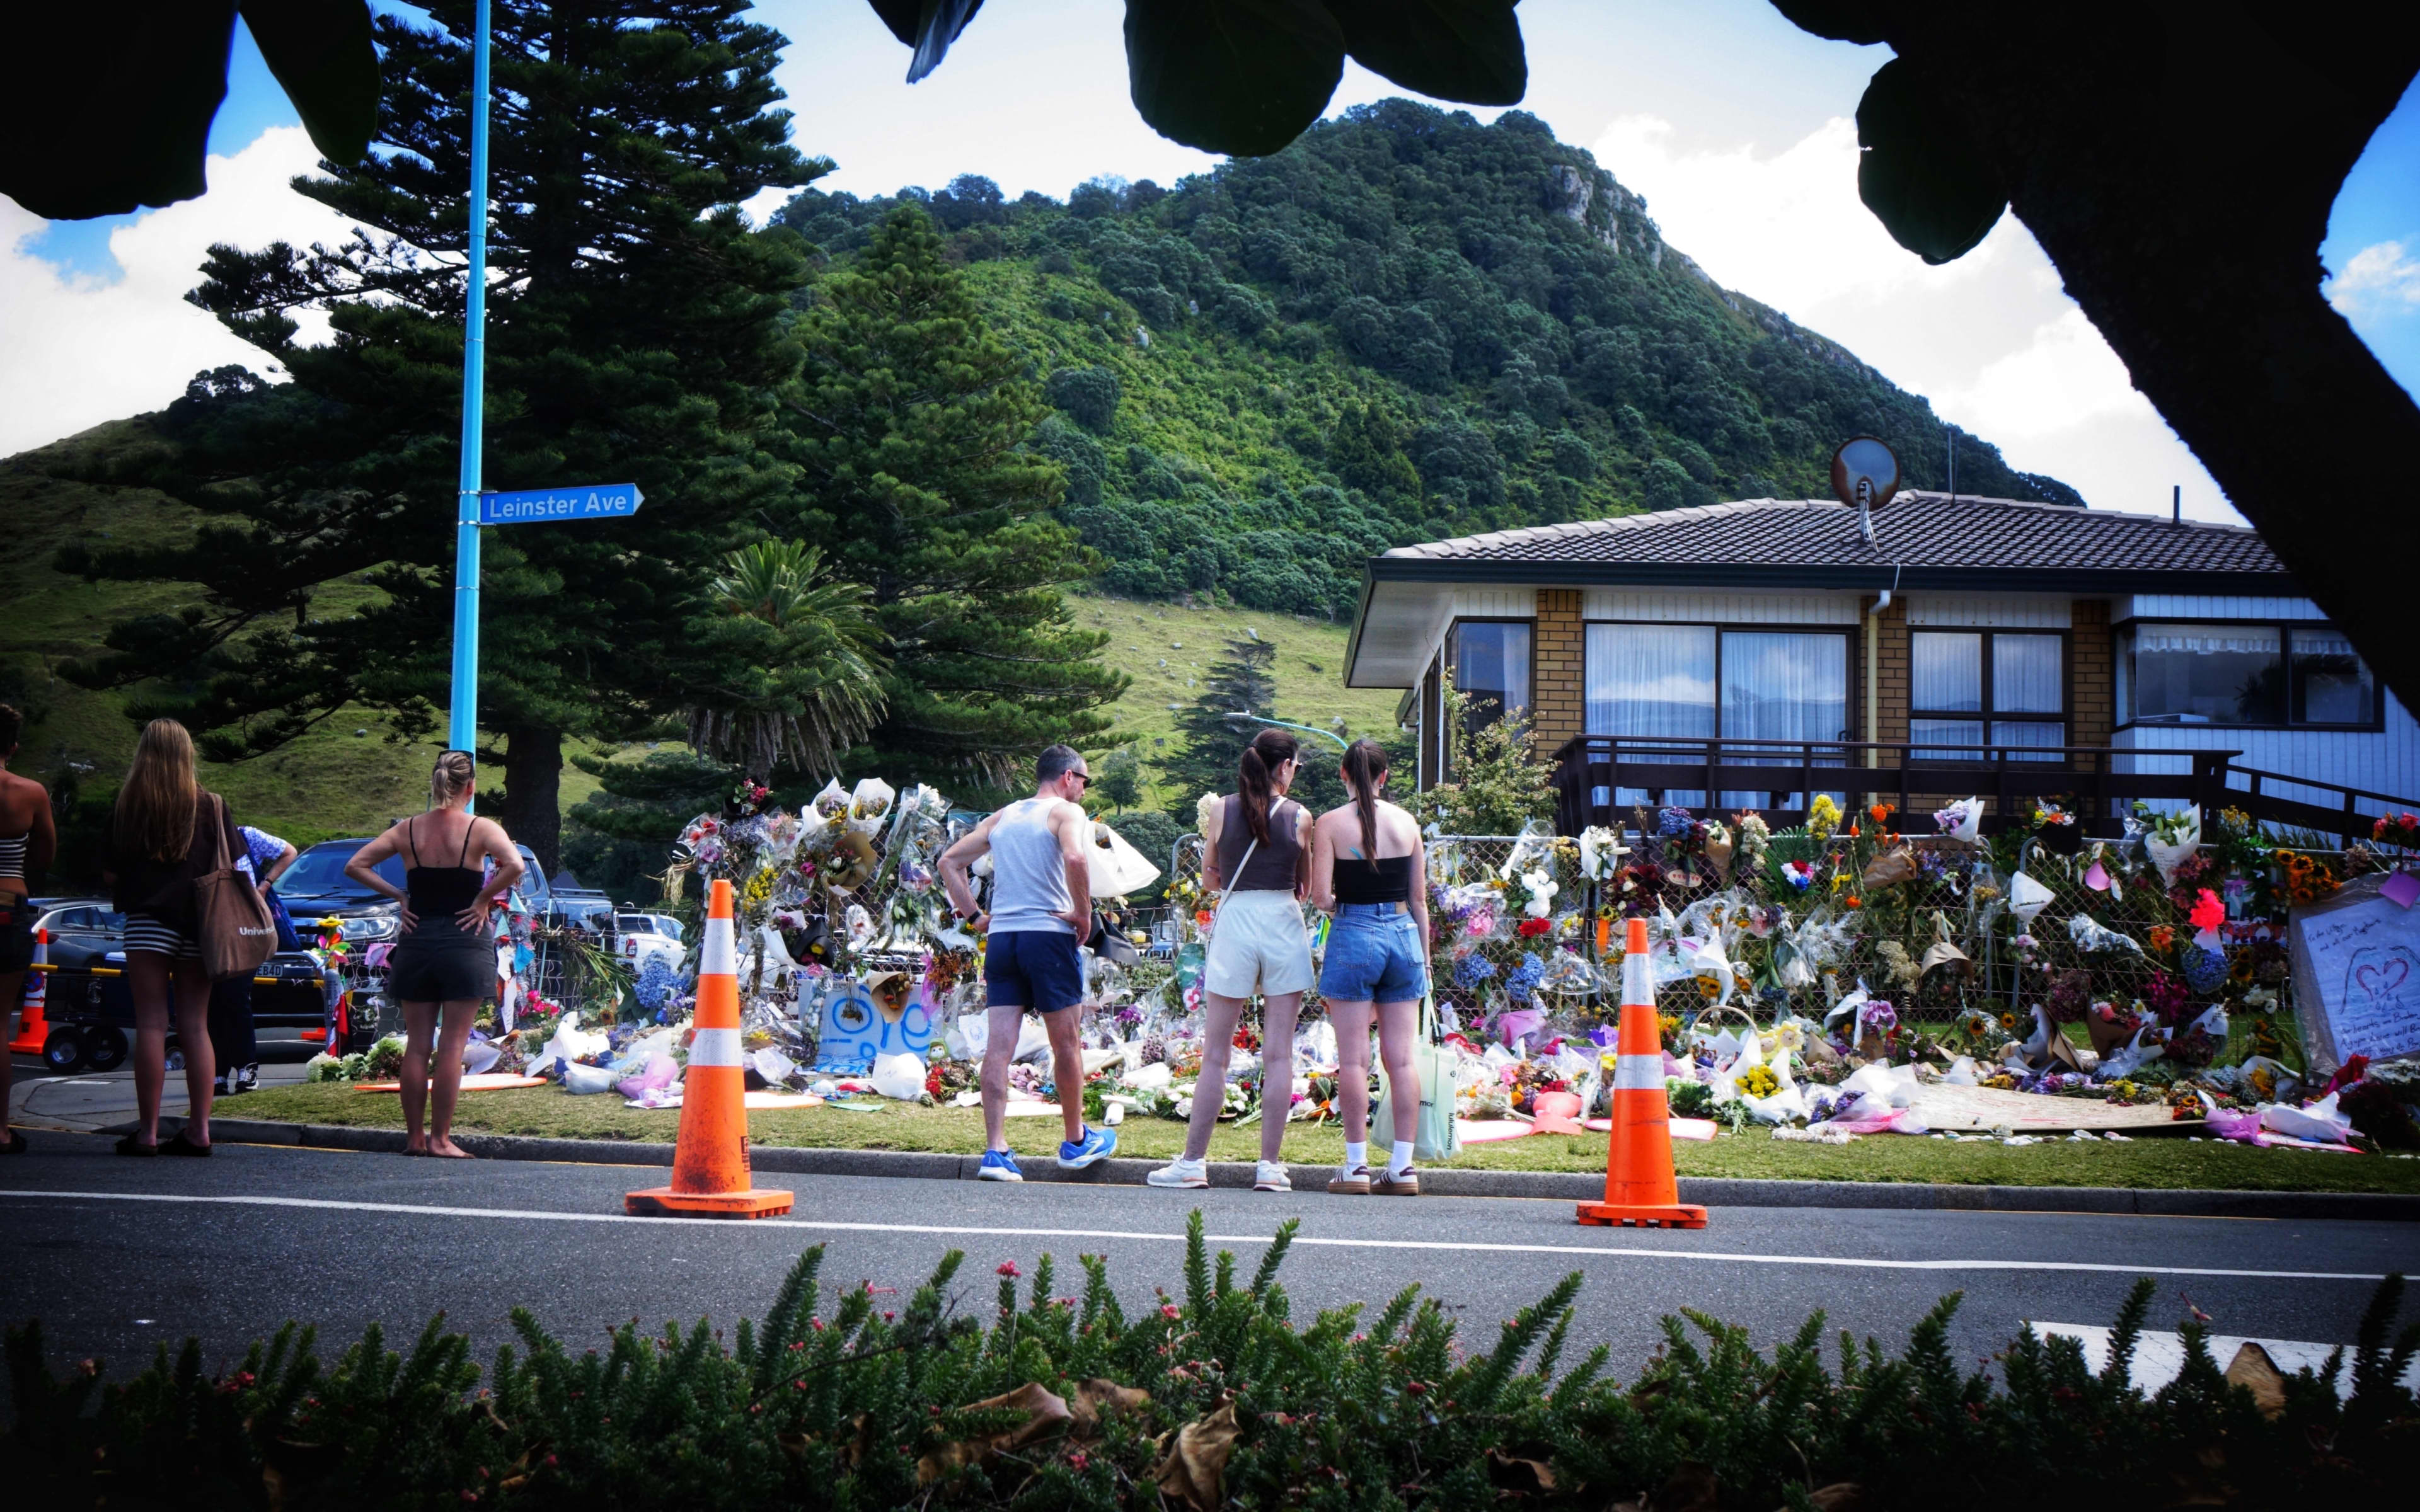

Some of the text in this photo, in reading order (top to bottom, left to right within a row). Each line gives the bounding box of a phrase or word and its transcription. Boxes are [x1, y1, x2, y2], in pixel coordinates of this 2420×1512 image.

[490, 493, 626, 518] Leinster Ave
[817, 985, 932, 1051] ove
[2353, 1018, 2380, 1034] hearts
